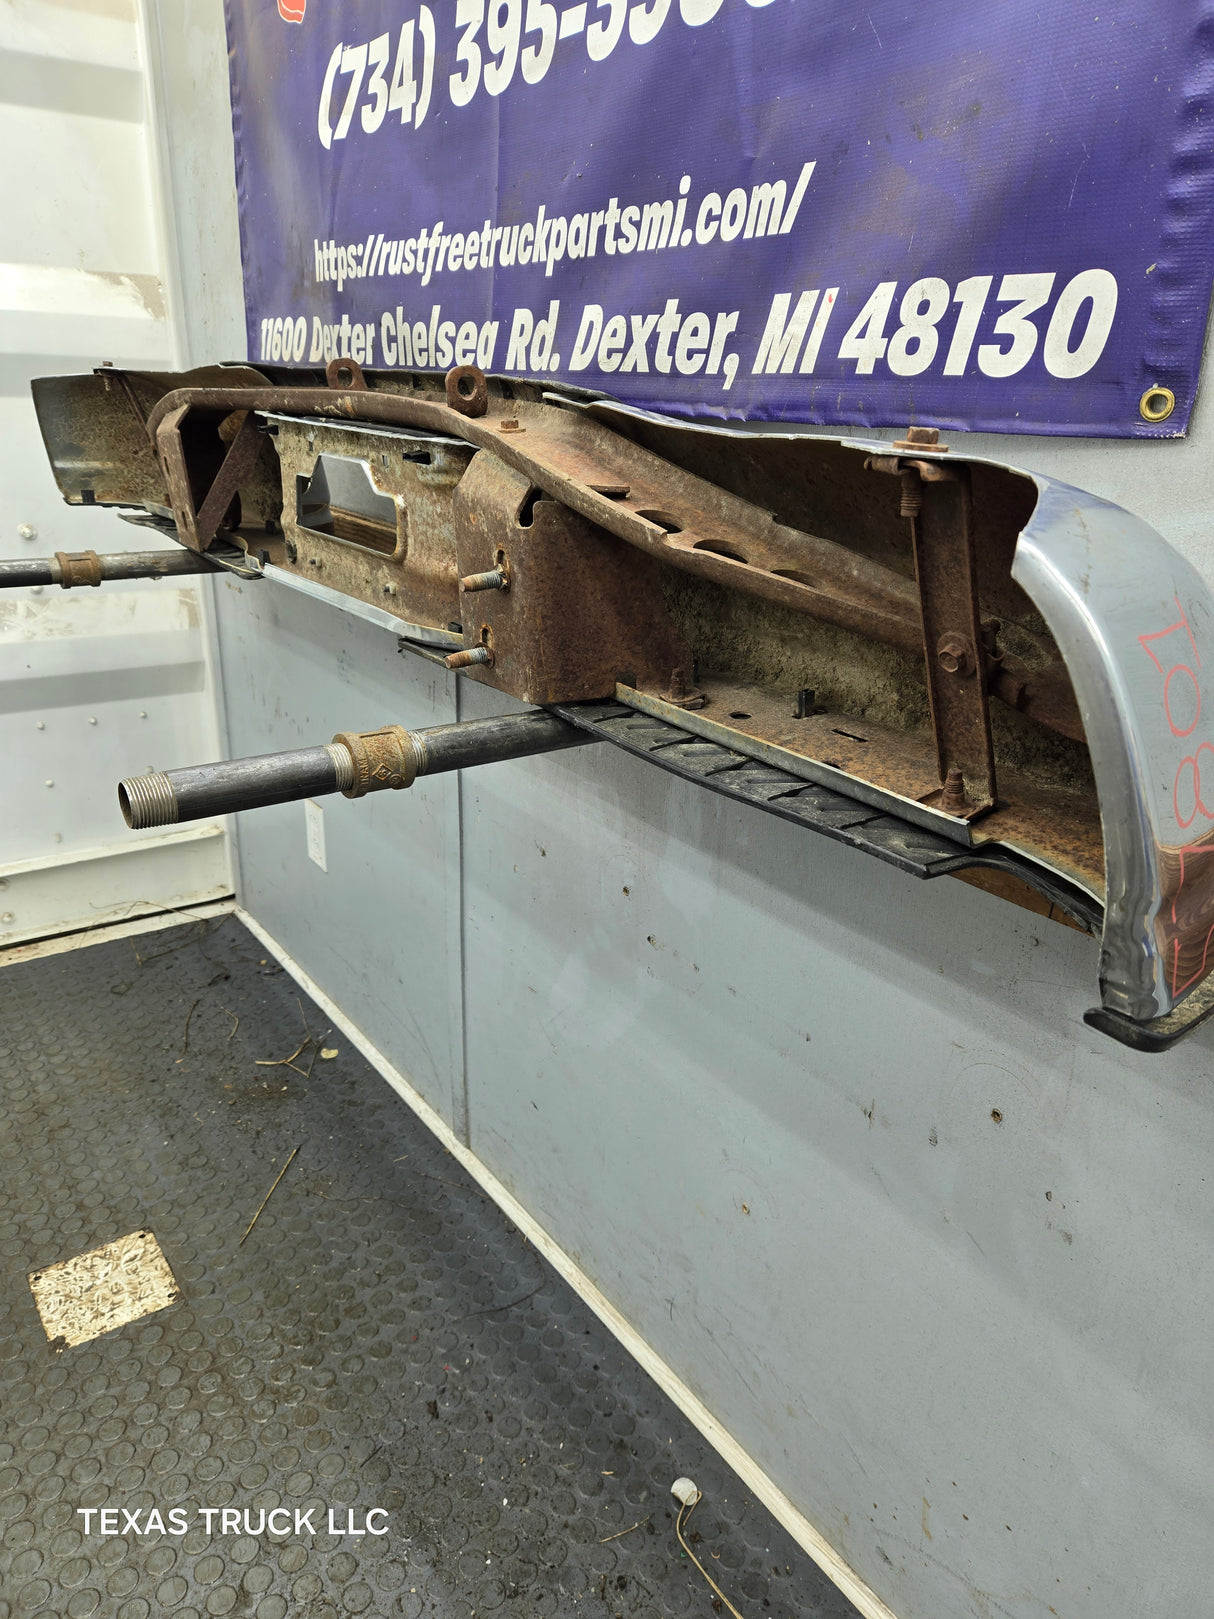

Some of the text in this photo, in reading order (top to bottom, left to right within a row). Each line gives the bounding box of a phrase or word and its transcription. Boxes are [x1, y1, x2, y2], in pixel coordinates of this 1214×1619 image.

[317, 0, 776, 151] (734) 395-
[313, 160, 818, 292] https://rustfreetruckpartsmi.com/
[259, 268, 1119, 391] 11600 Dexter Chelsea Rd. Dexter, MI 48130
